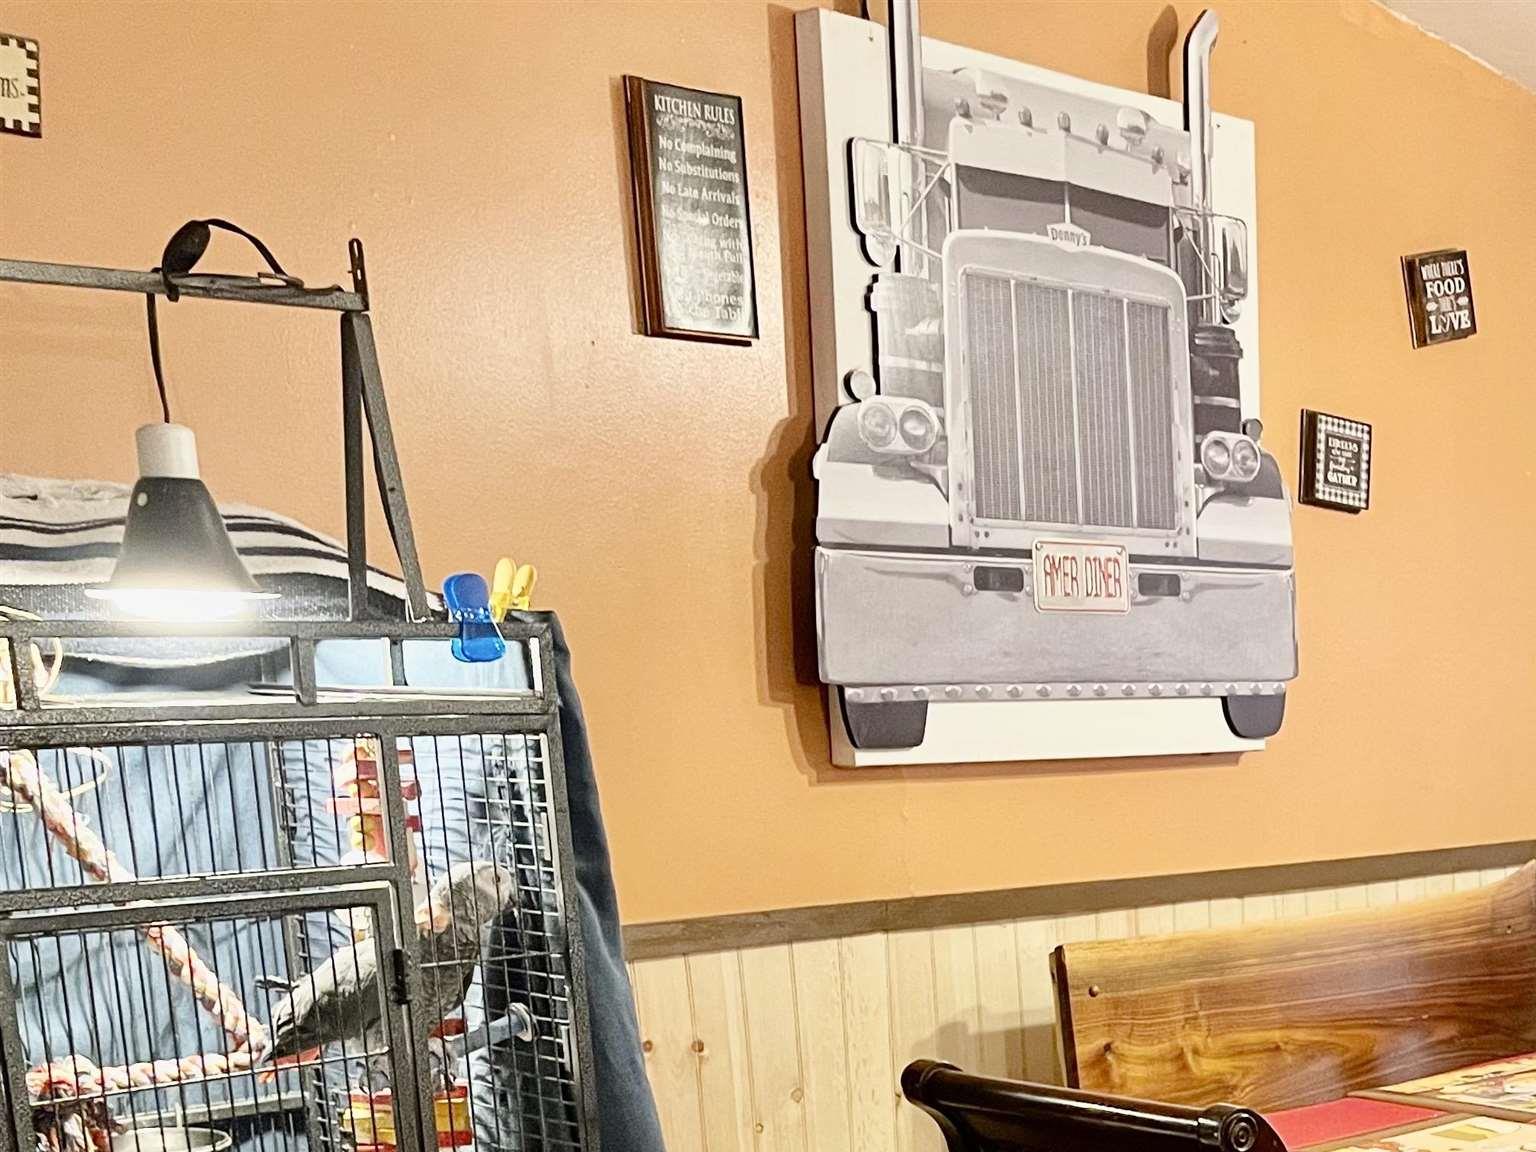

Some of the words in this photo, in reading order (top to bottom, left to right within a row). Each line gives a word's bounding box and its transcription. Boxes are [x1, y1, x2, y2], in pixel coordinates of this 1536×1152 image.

[654, 94, 701, 117] KITCHEN
[704, 104, 735, 126] RULES
[658, 136, 673, 150] No
[675, 138, 737, 164] Complaining
[658, 157, 673, 171] No
[674, 160, 740, 183] Substitutions
[662, 181, 676, 194] No
[678, 183, 699, 200] Late
[701, 187, 741, 205] Arrivals
[1051, 227, 1087, 246] Denny's
[1425, 277, 1466, 299] FOOD
[1043, 554, 1079, 598] AMER
[1084, 556, 1122, 599] DINER
